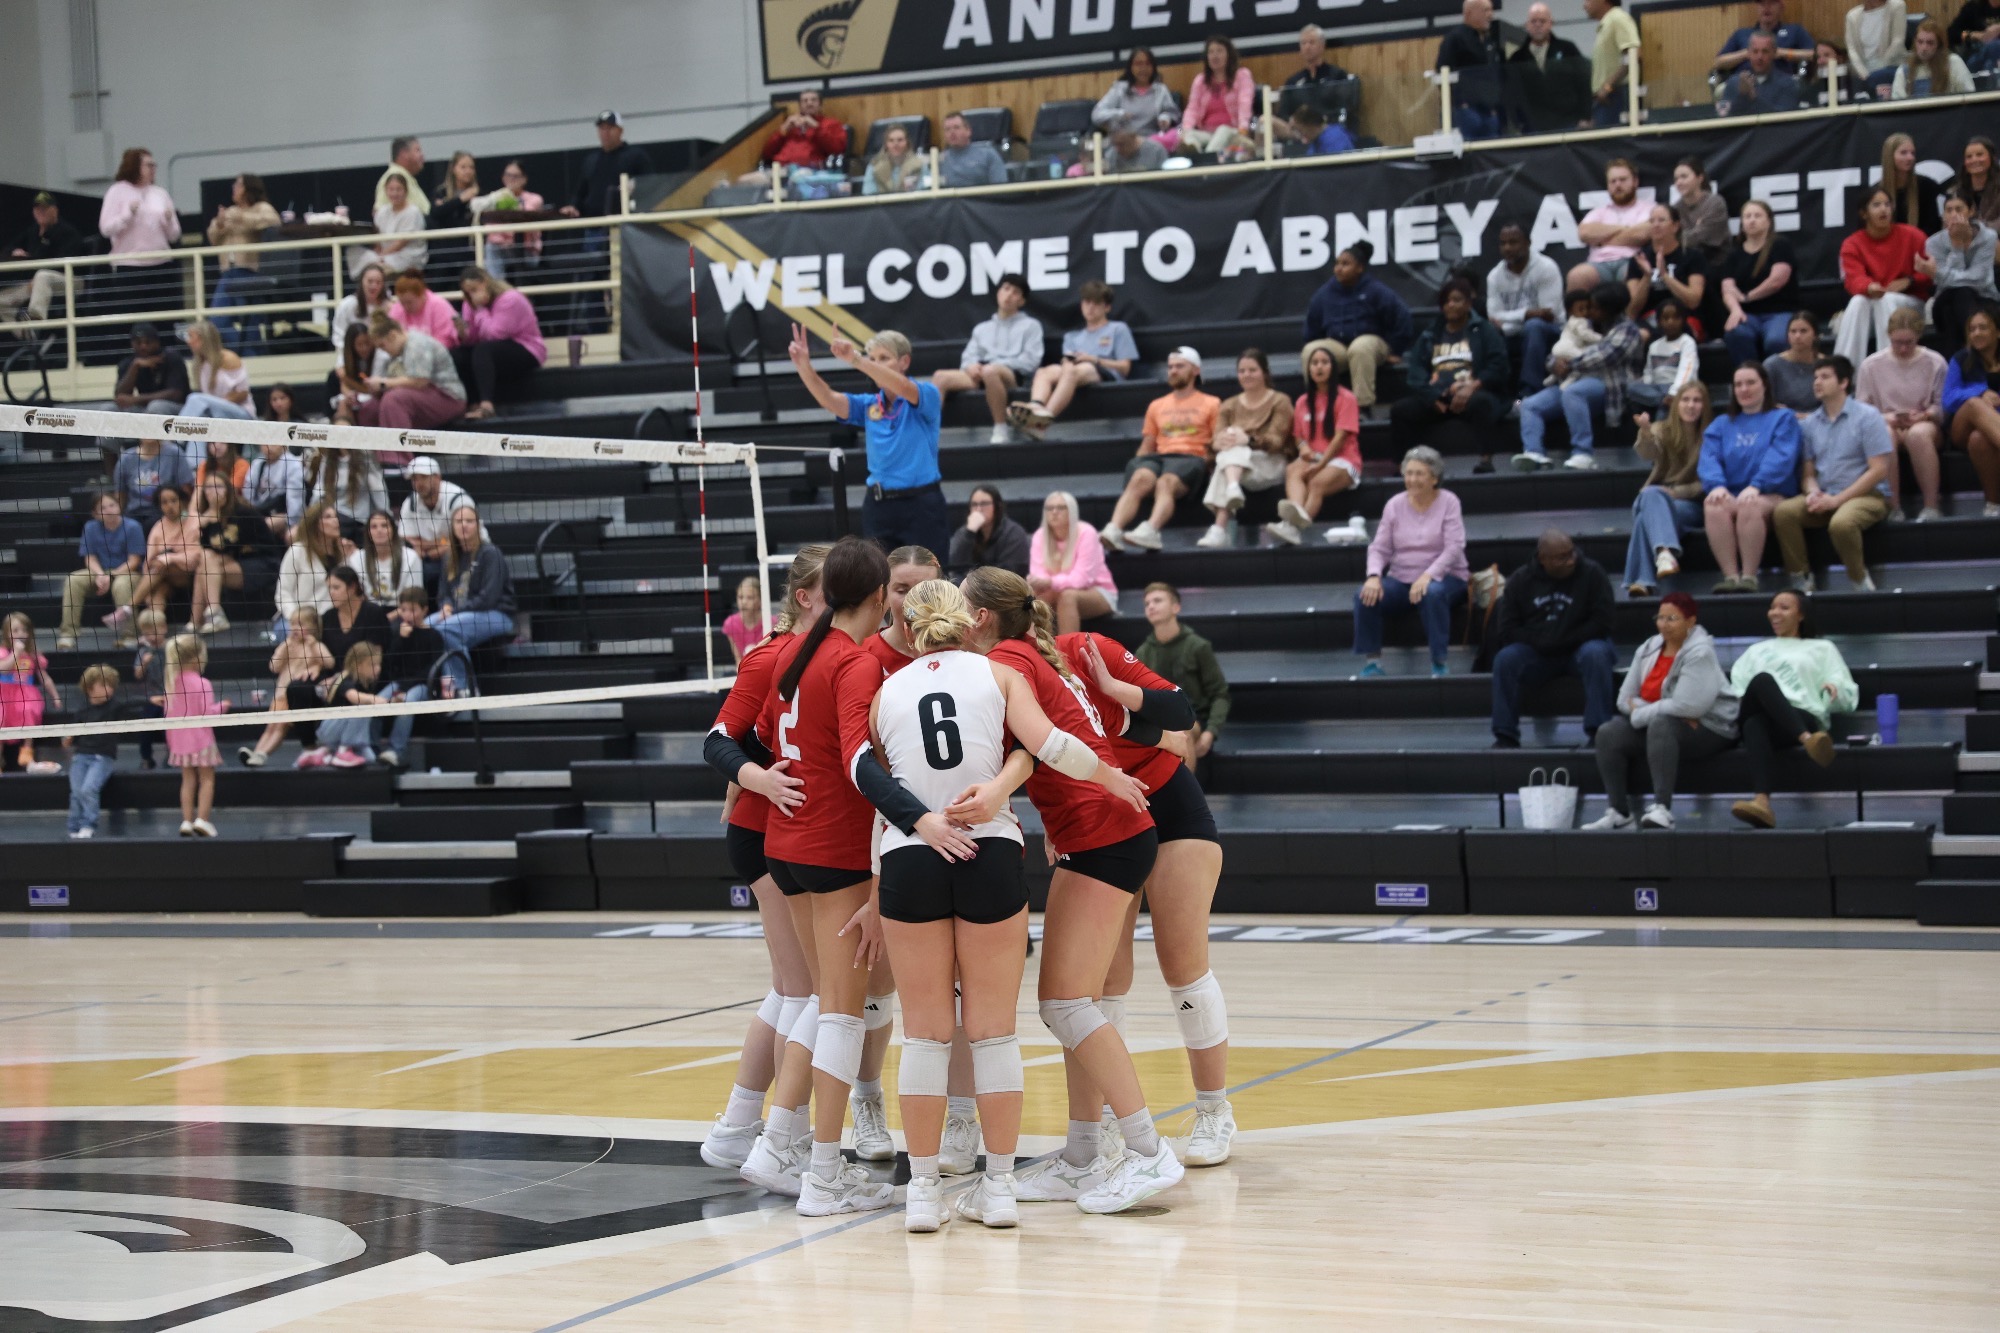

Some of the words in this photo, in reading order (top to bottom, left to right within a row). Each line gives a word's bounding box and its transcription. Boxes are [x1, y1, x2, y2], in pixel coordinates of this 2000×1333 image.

[709, 235, 1070, 313] WELCOME
[1093, 226, 1196, 284] TO
[1220, 199, 1500, 277] ABNEY
[36, 417, 75, 427] TROJANS
[174, 426, 208, 435] TROJANS
[918, 692, 964, 771] 6
